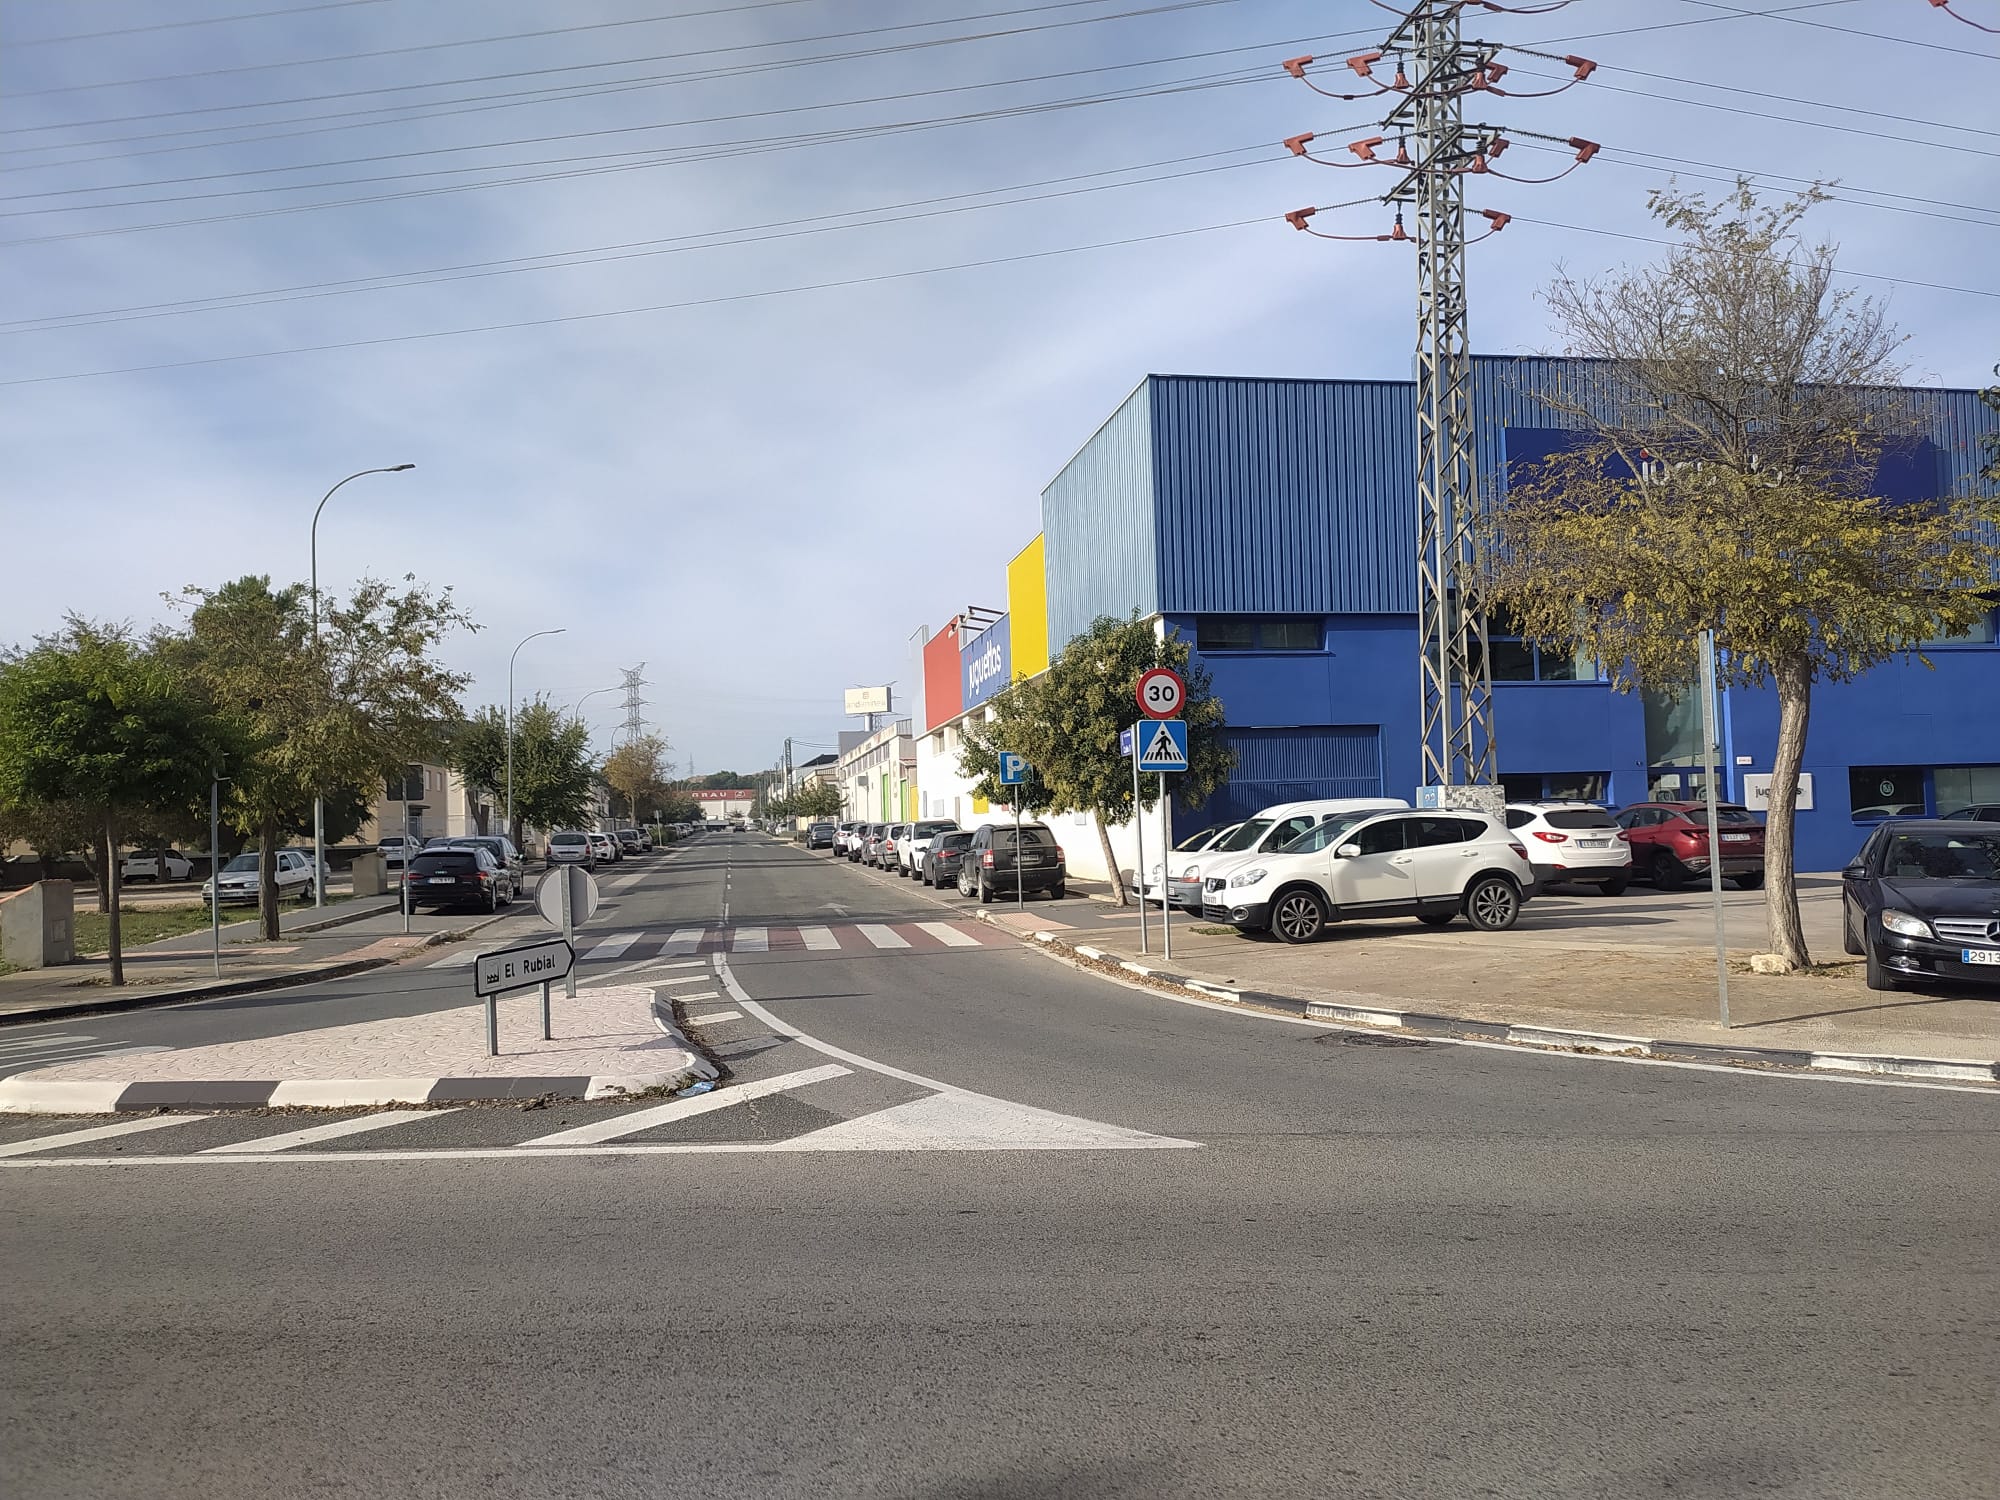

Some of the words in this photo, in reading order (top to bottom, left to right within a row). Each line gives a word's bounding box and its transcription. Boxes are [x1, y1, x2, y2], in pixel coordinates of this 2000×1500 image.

[1148, 685, 1175, 702] 30
[1006, 755, 1026, 780] P
[504, 962, 515, 978] El
[523, 954, 556, 974] Rubial
